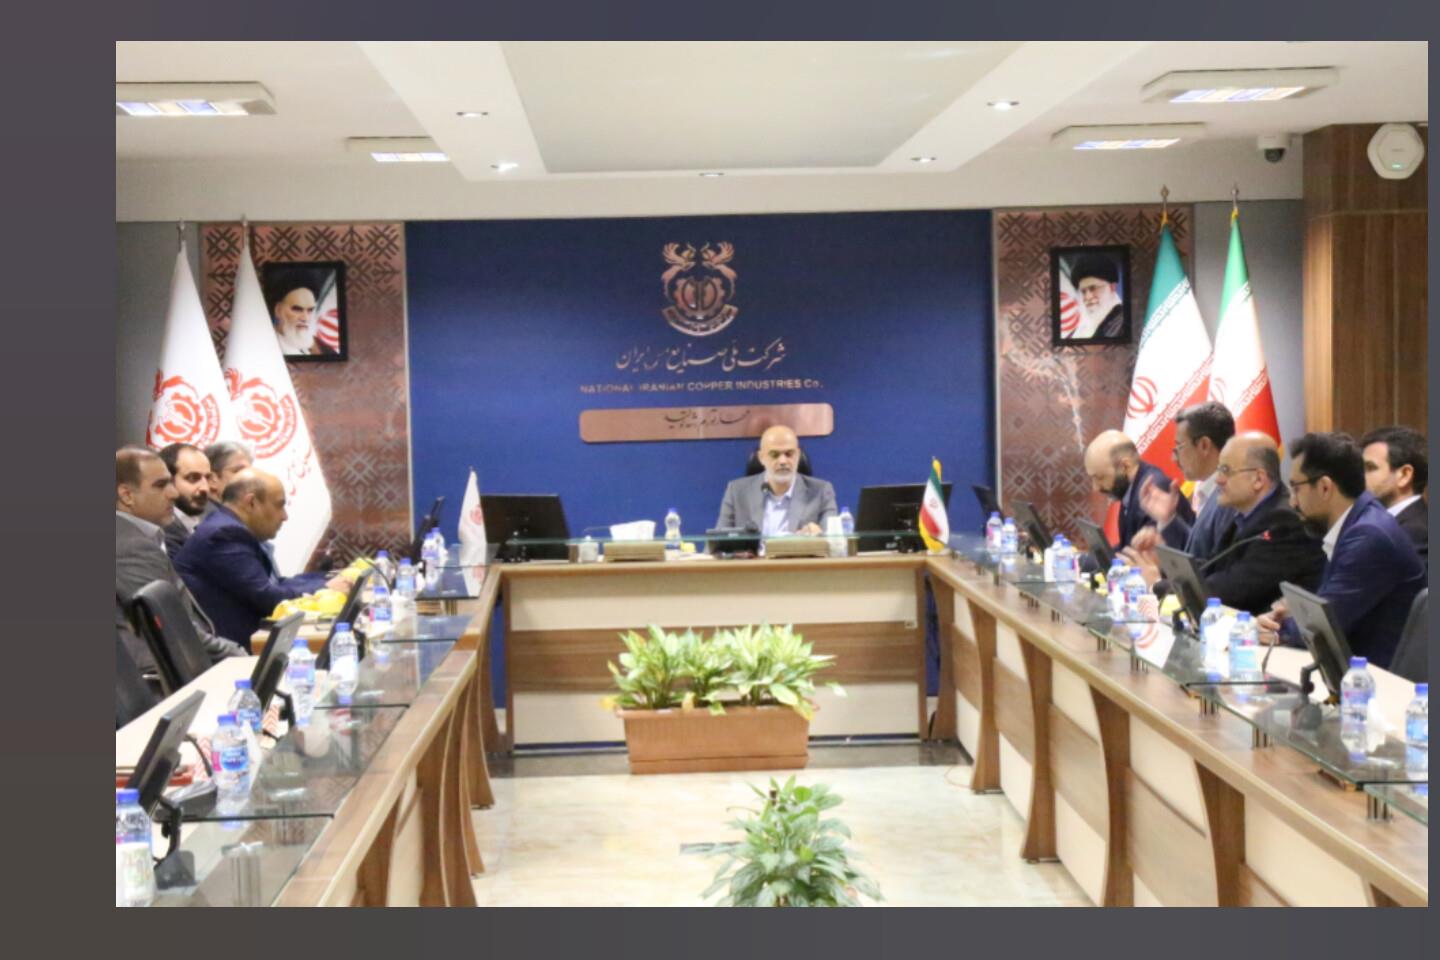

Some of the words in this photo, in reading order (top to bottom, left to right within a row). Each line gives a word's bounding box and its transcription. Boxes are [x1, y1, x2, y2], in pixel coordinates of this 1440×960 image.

[736, 337, 787, 371] شرکت
[687, 381, 733, 391] COPPER
[735, 379, 802, 390] INDUSTRIES
